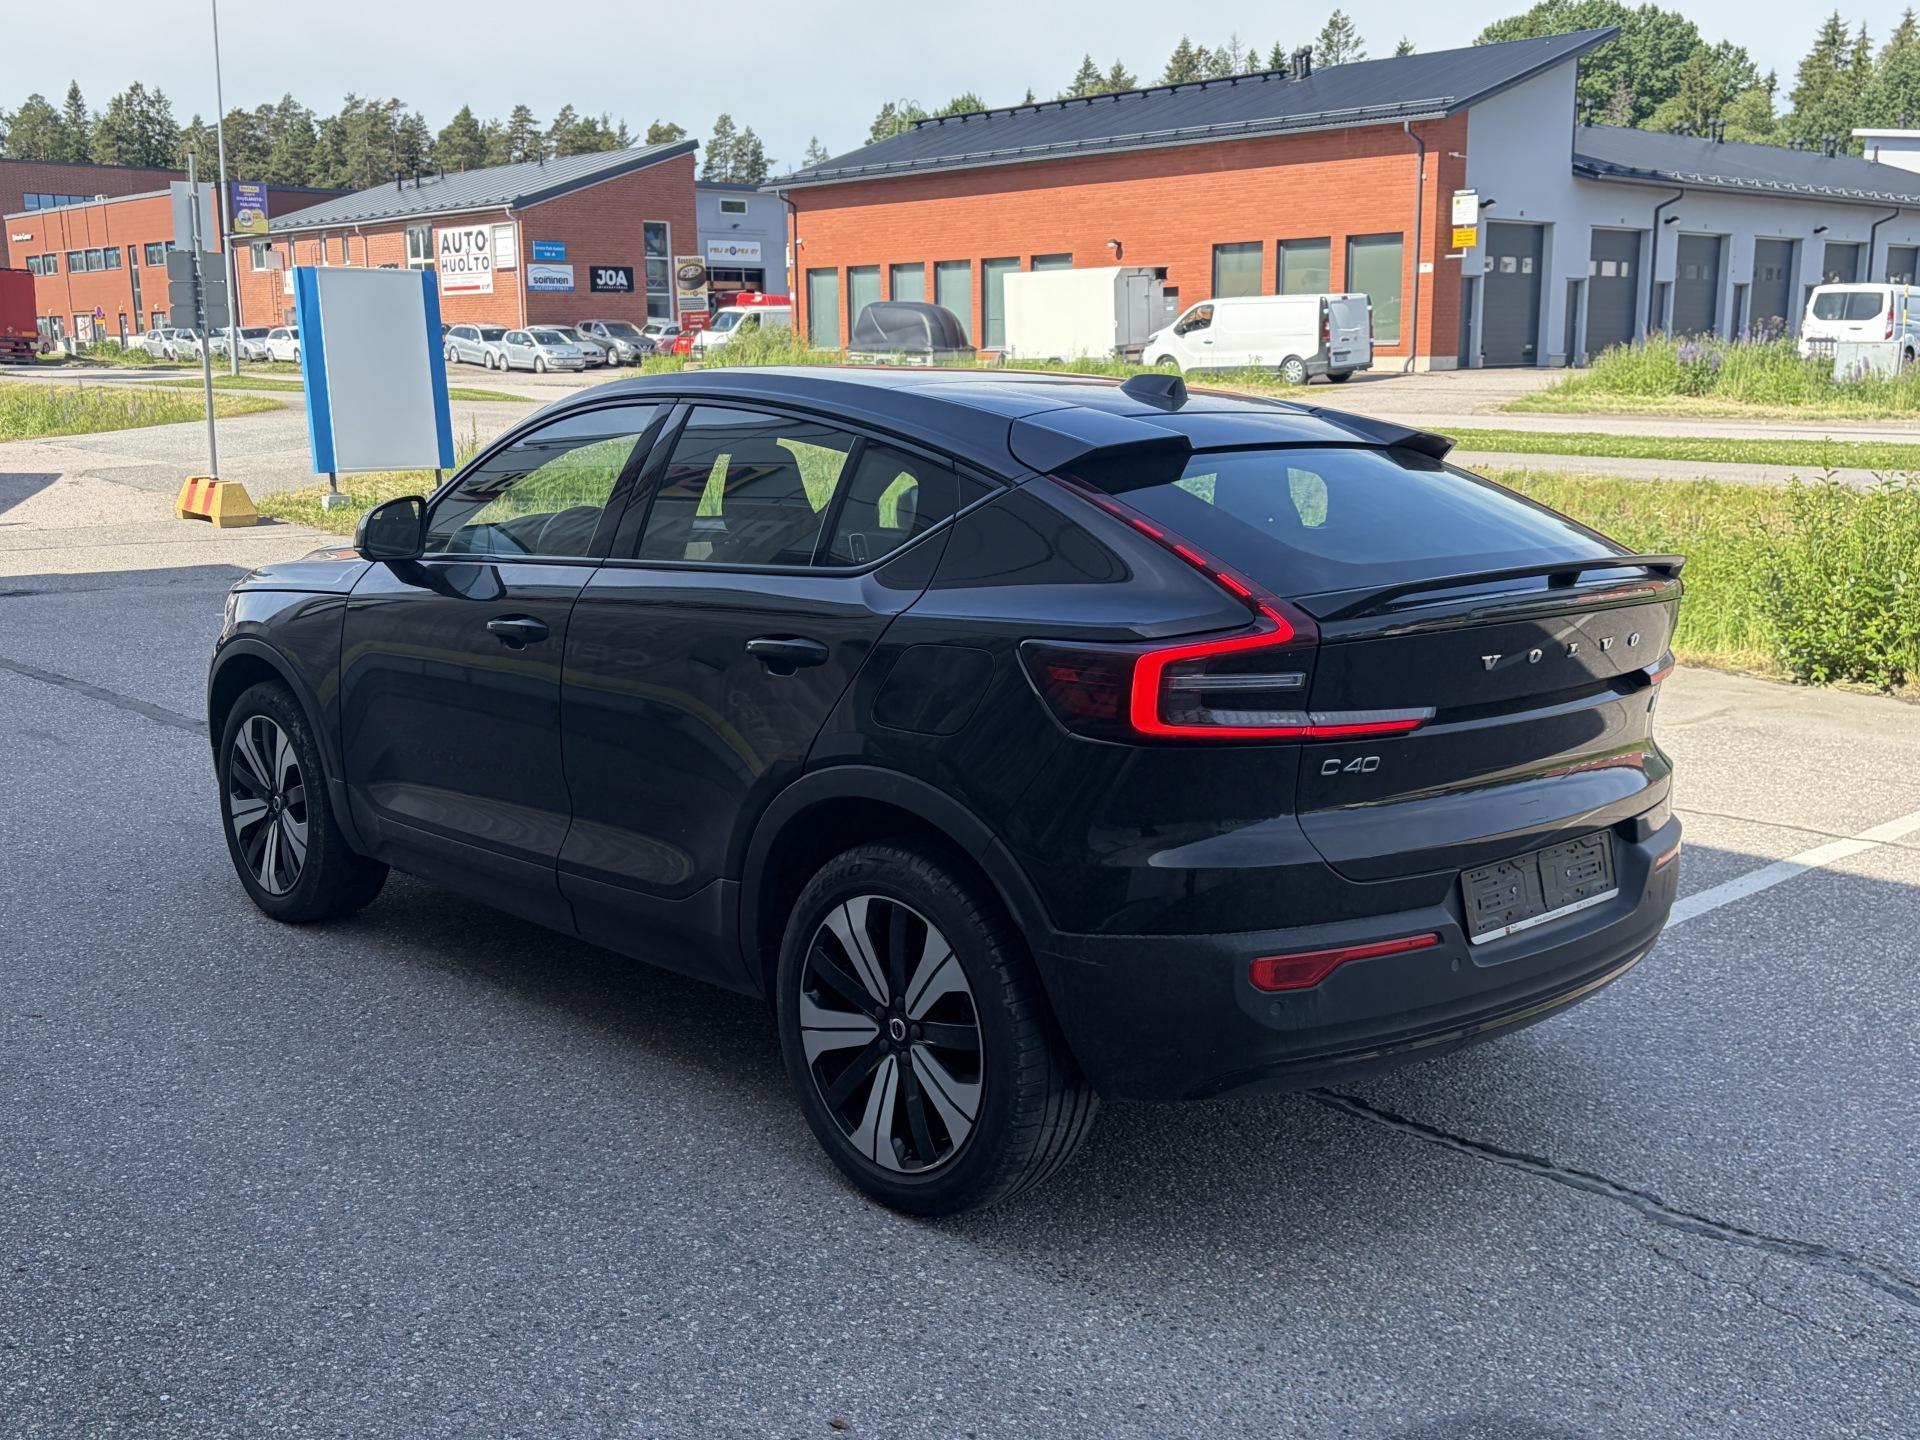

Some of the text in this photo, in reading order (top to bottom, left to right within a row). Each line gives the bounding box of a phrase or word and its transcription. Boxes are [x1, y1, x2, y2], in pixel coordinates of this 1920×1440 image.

[441, 256, 490, 273] HUOLTO
[533, 275, 569, 285] soininen
[596, 269, 628, 286] JOA
[1481, 632, 1641, 671] VOLVO
[1320, 756, 1381, 776] C40
